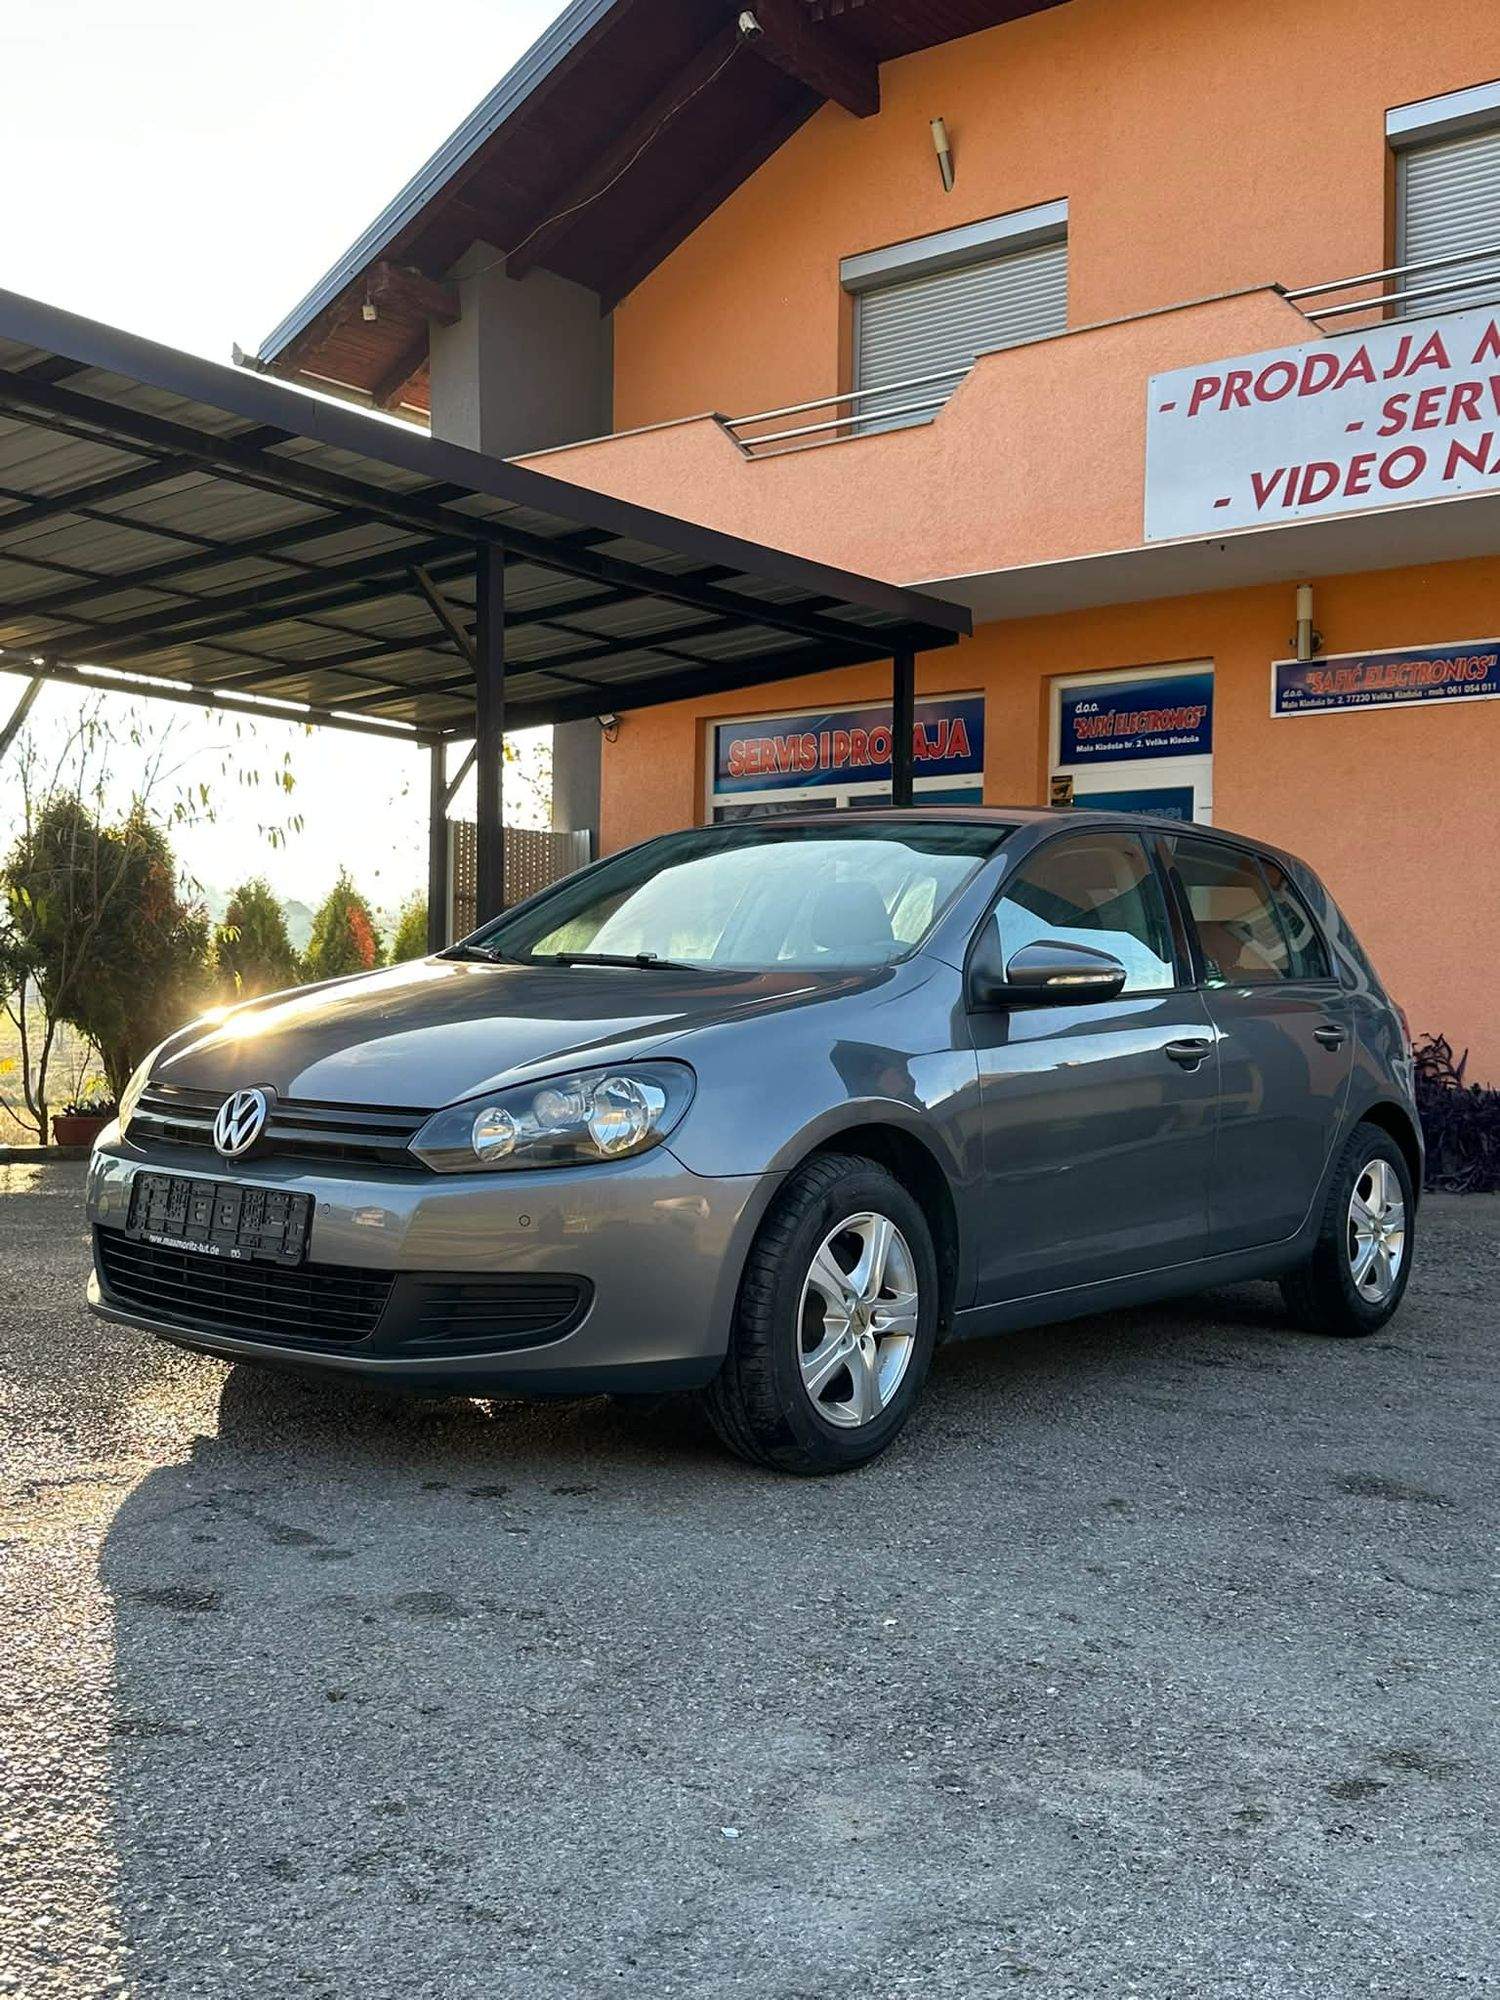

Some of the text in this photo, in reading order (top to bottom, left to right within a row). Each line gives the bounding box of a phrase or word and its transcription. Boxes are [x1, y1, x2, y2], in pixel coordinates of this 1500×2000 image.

[1187, 330, 1451, 417] PRODAJA
[1251, 446, 1427, 511] VIDEO
[728, 718, 971, 777] SERVIS I PROAJA
